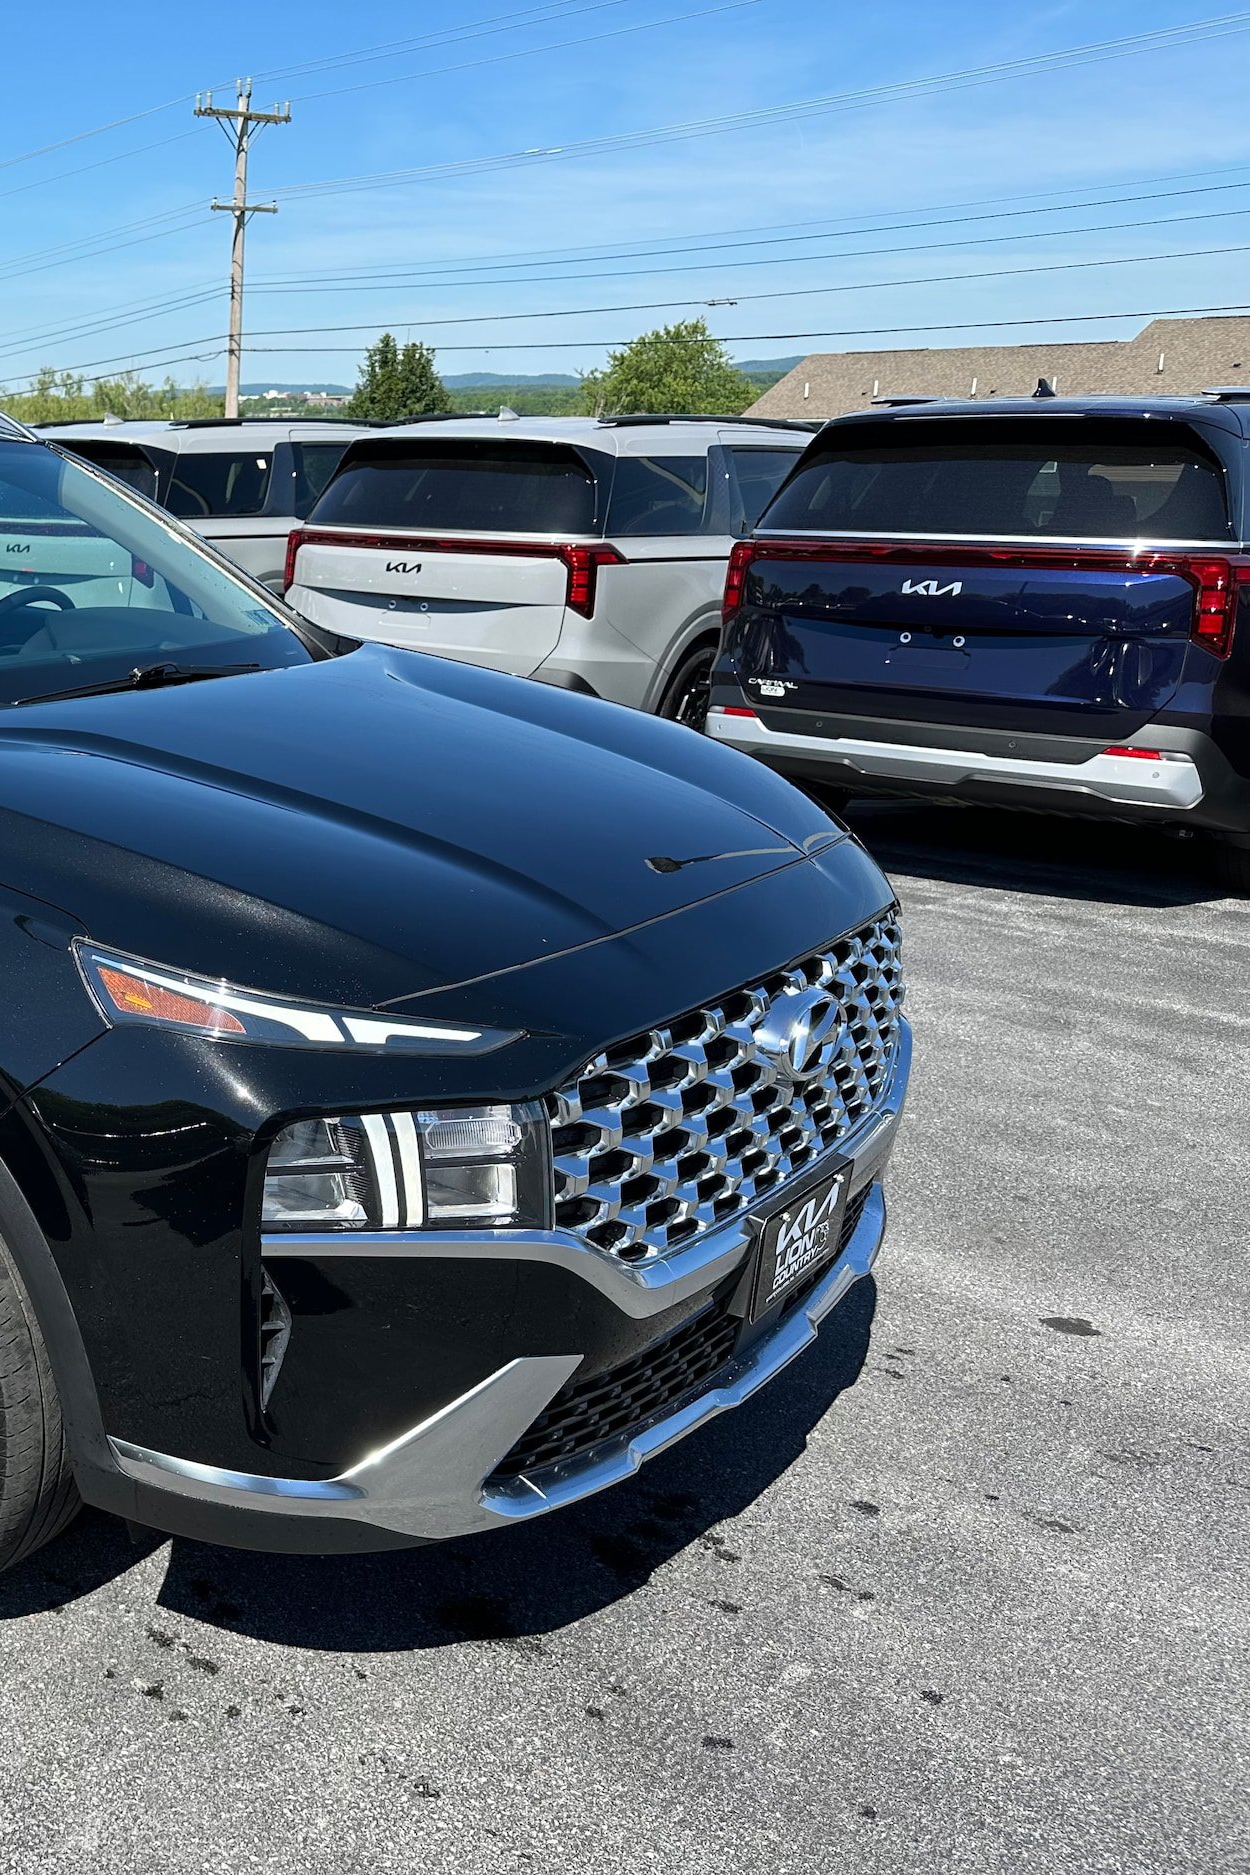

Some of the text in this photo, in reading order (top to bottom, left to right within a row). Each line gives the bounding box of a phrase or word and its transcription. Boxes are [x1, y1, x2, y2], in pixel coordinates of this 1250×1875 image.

[6, 544, 30, 553] KIA
[386, 561, 422, 574] KIA
[901, 579, 963, 597] KIA
[776, 1182, 839, 1255] KIA
[775, 1228, 816, 1277] LION
[772, 1247, 817, 1290] COUNTRY
